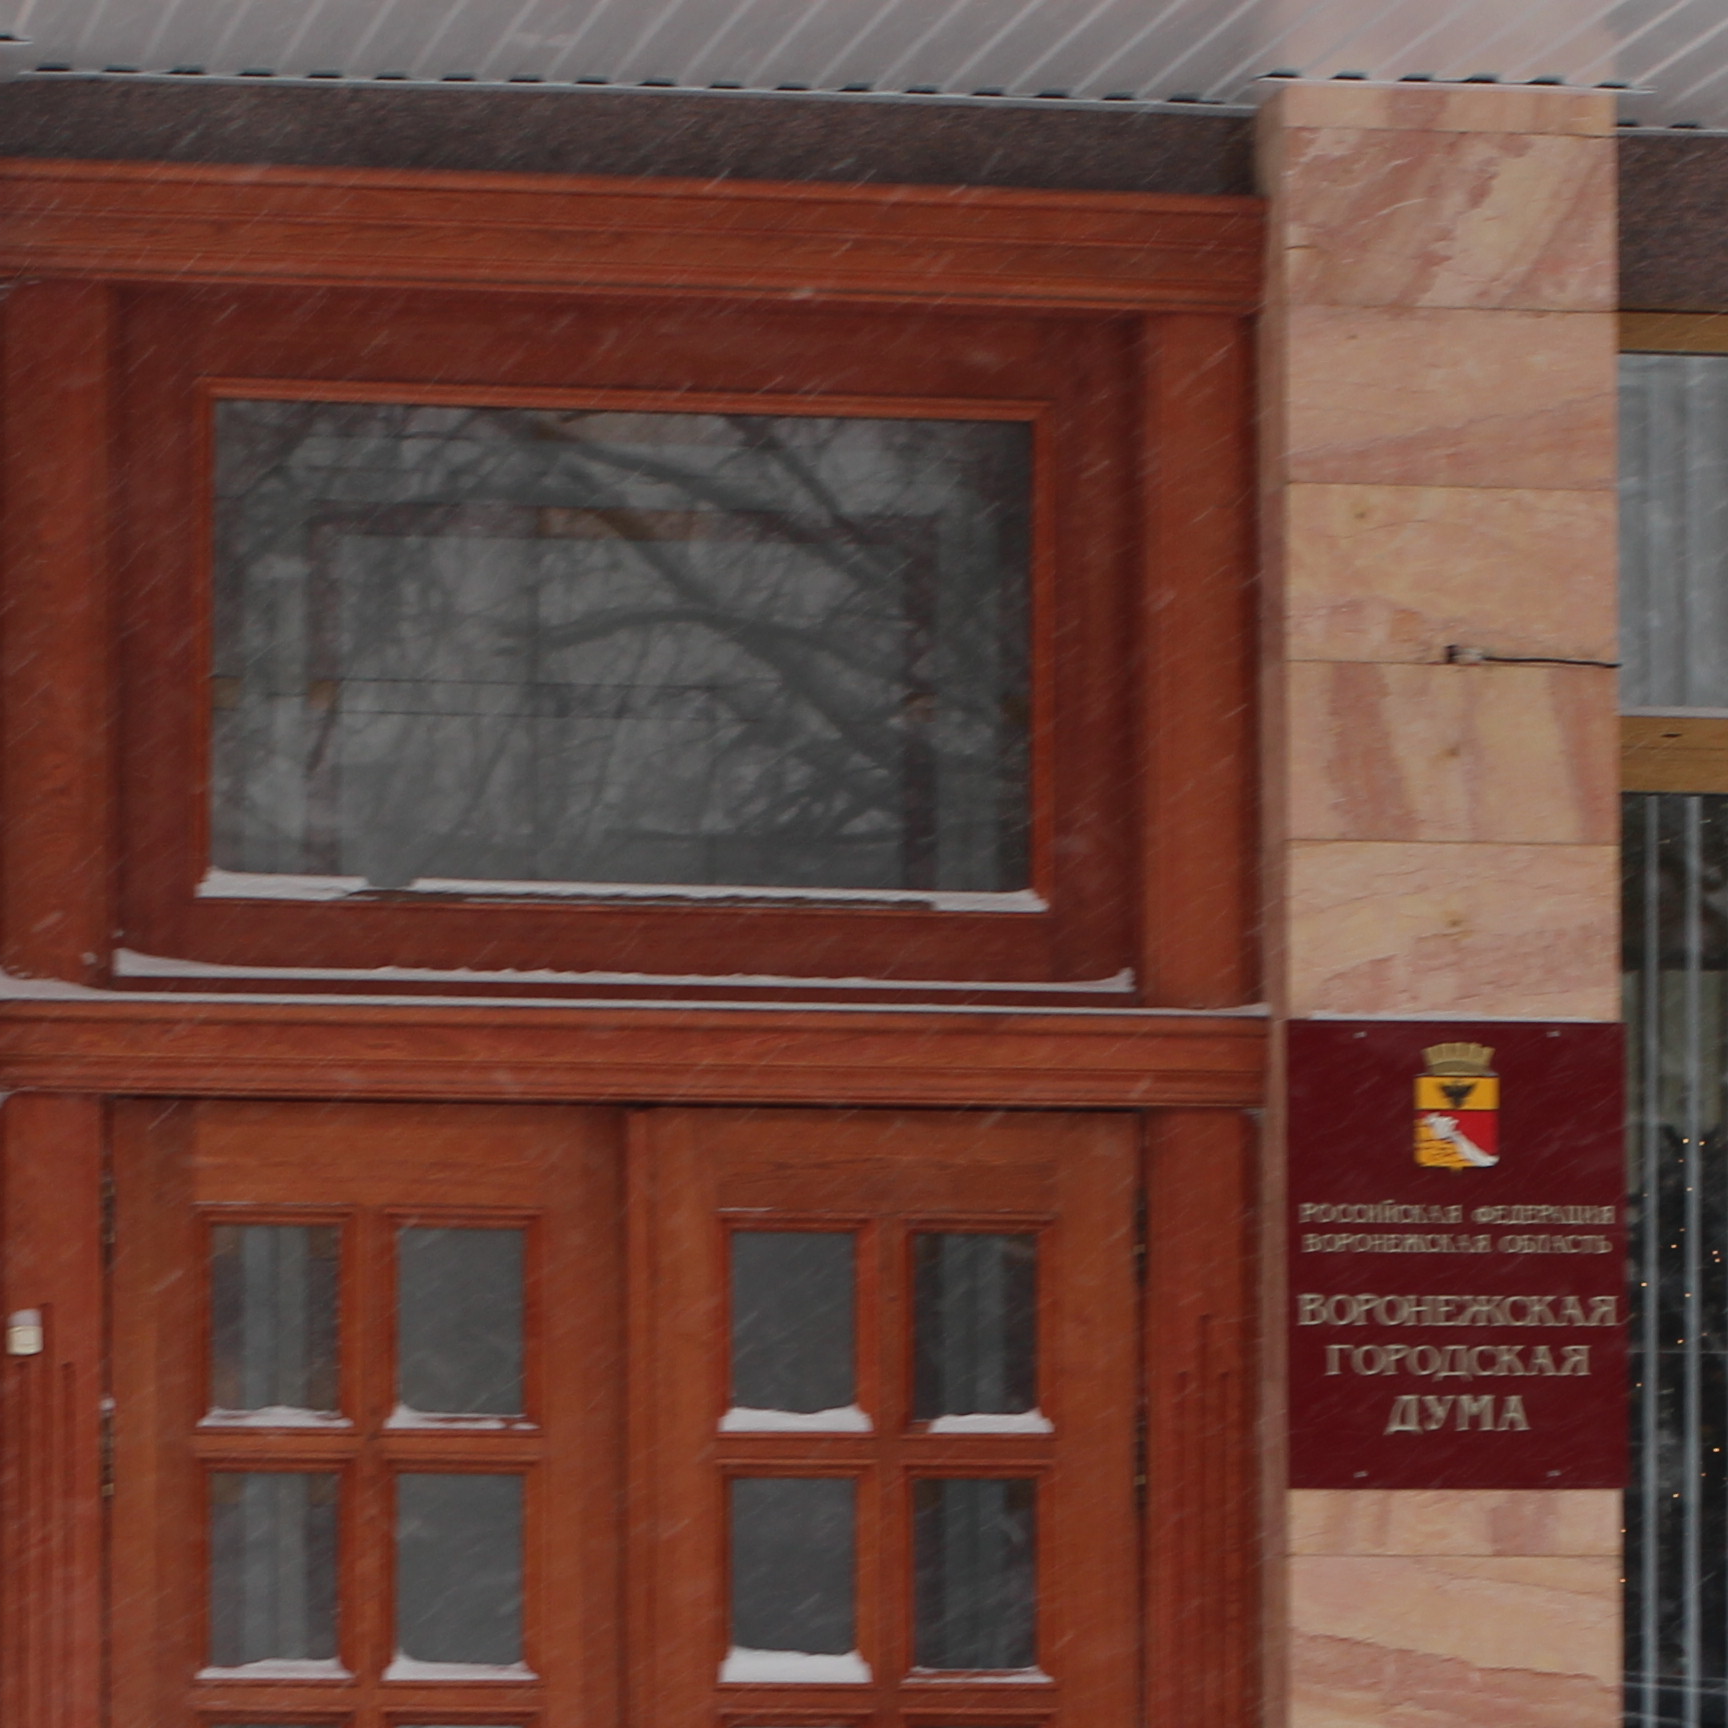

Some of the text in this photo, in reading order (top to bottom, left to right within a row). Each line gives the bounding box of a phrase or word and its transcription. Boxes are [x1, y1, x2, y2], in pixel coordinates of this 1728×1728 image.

[1298, 1200, 1616, 1225] РОССИЙСКАЯ ФЕДЕРАЦИЯ
[1302, 1232, 1613, 1254] ВОРОНЕЖСКАЯ ОБЛАСТЬ
[1297, 1294, 1619, 1326] ВОРОНЕЖСКАЯ
[1324, 1344, 1591, 1380] ГОРОДСКАЯ
[1384, 1394, 1531, 1434] ДУМА
